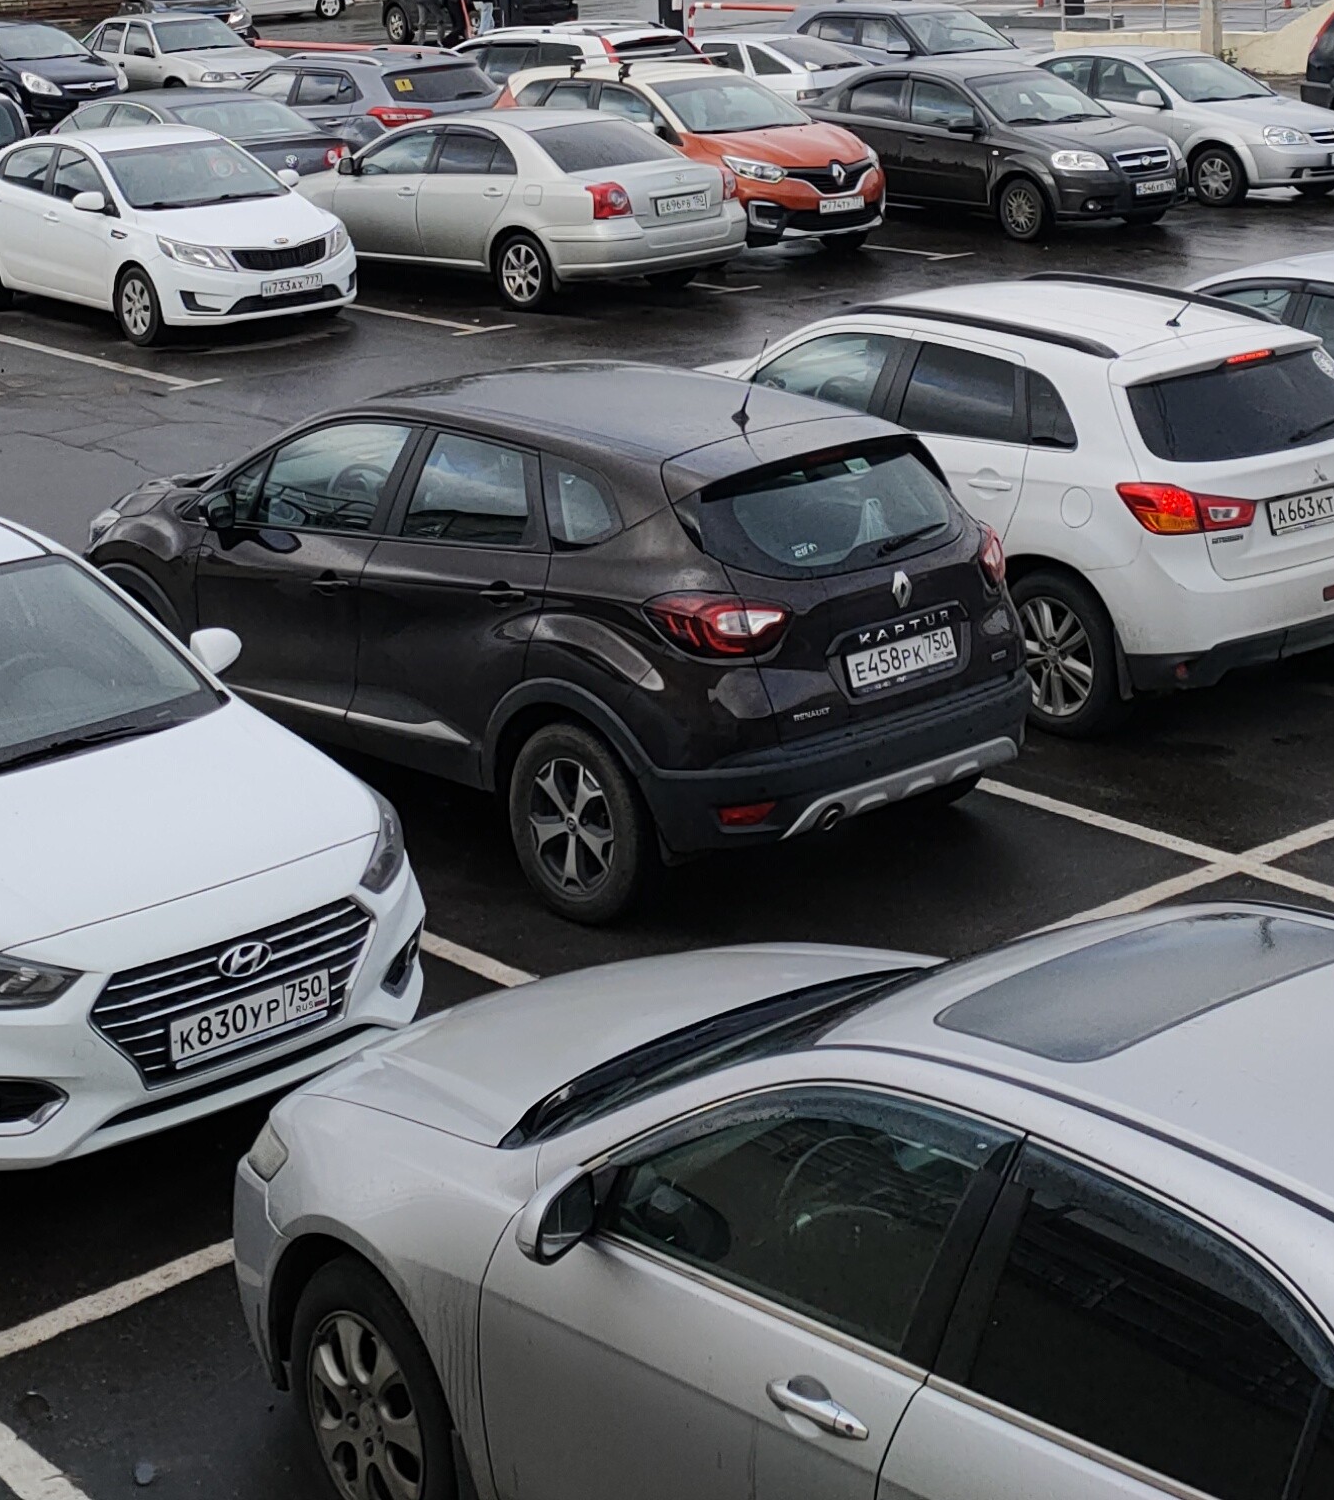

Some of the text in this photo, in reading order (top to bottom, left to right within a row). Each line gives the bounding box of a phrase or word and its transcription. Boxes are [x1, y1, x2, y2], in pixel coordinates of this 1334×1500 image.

[858, 609, 951, 645] KAPTUR
[923, 630, 950, 655] 750
[793, 706, 831, 722] RENAULT
[285, 975, 322, 1008] 750
[295, 1001, 315, 1014] RUS
